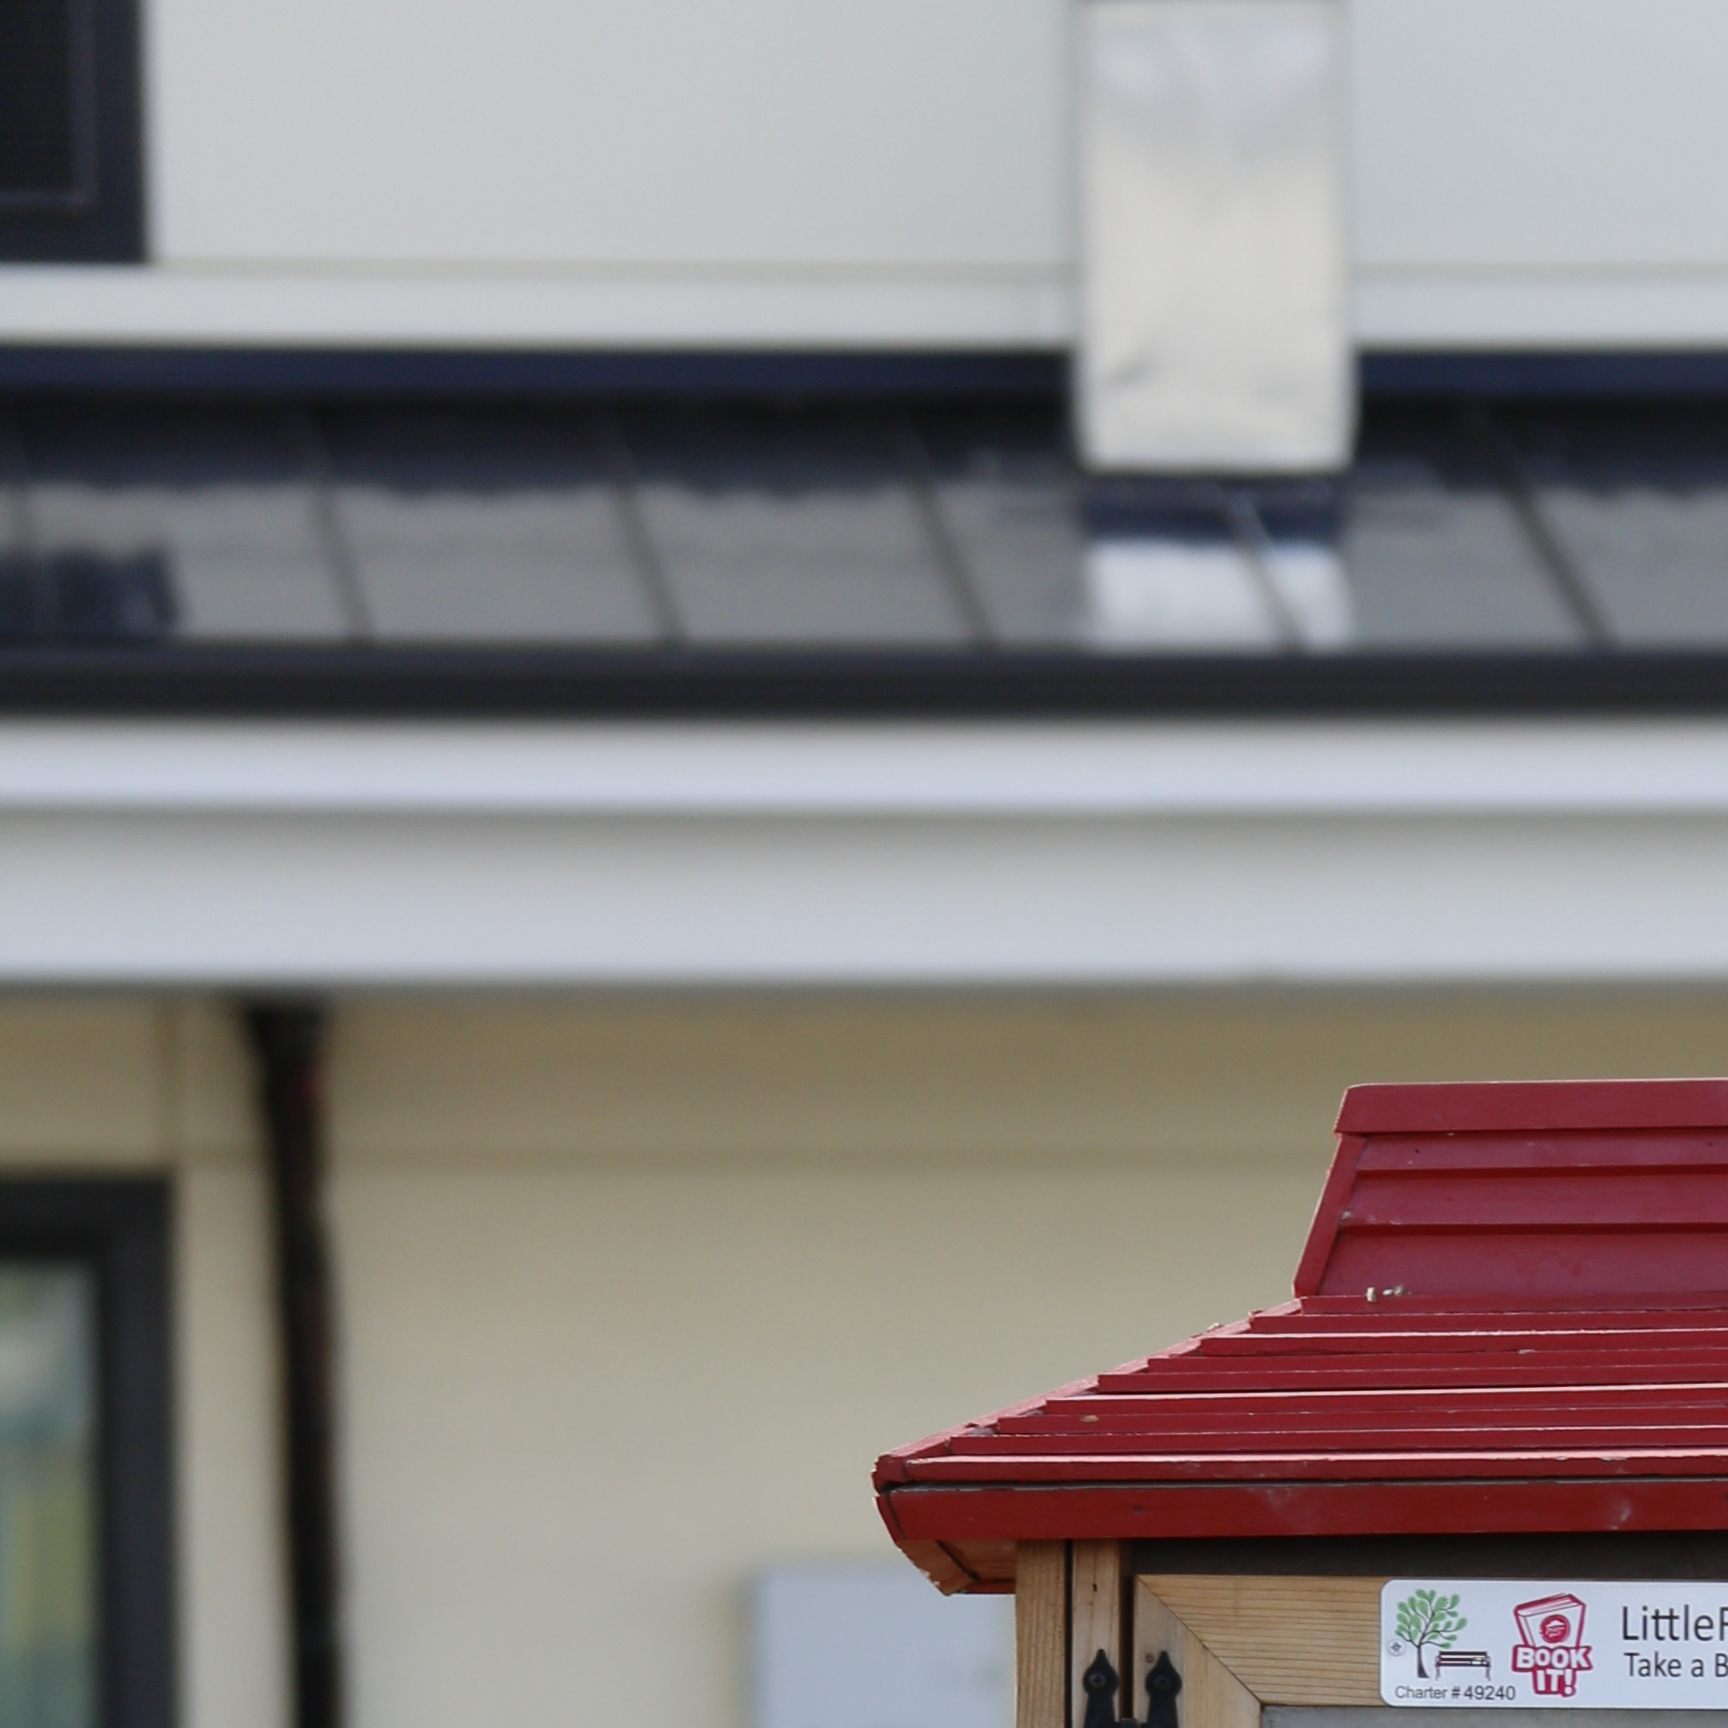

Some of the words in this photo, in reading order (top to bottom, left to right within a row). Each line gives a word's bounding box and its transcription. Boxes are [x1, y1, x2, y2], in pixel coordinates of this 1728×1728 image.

[1516, 1648, 1588, 1669] BOOK
[1624, 1651, 1682, 1677] Take
[1691, 1658, 1704, 1678] a
[1394, 1685, 1447, 1699] Charter
[1451, 1686, 1461, 1699] #
[1464, 1685, 1516, 1700] 49240
[1536, 1668, 1574, 1696] IT!
